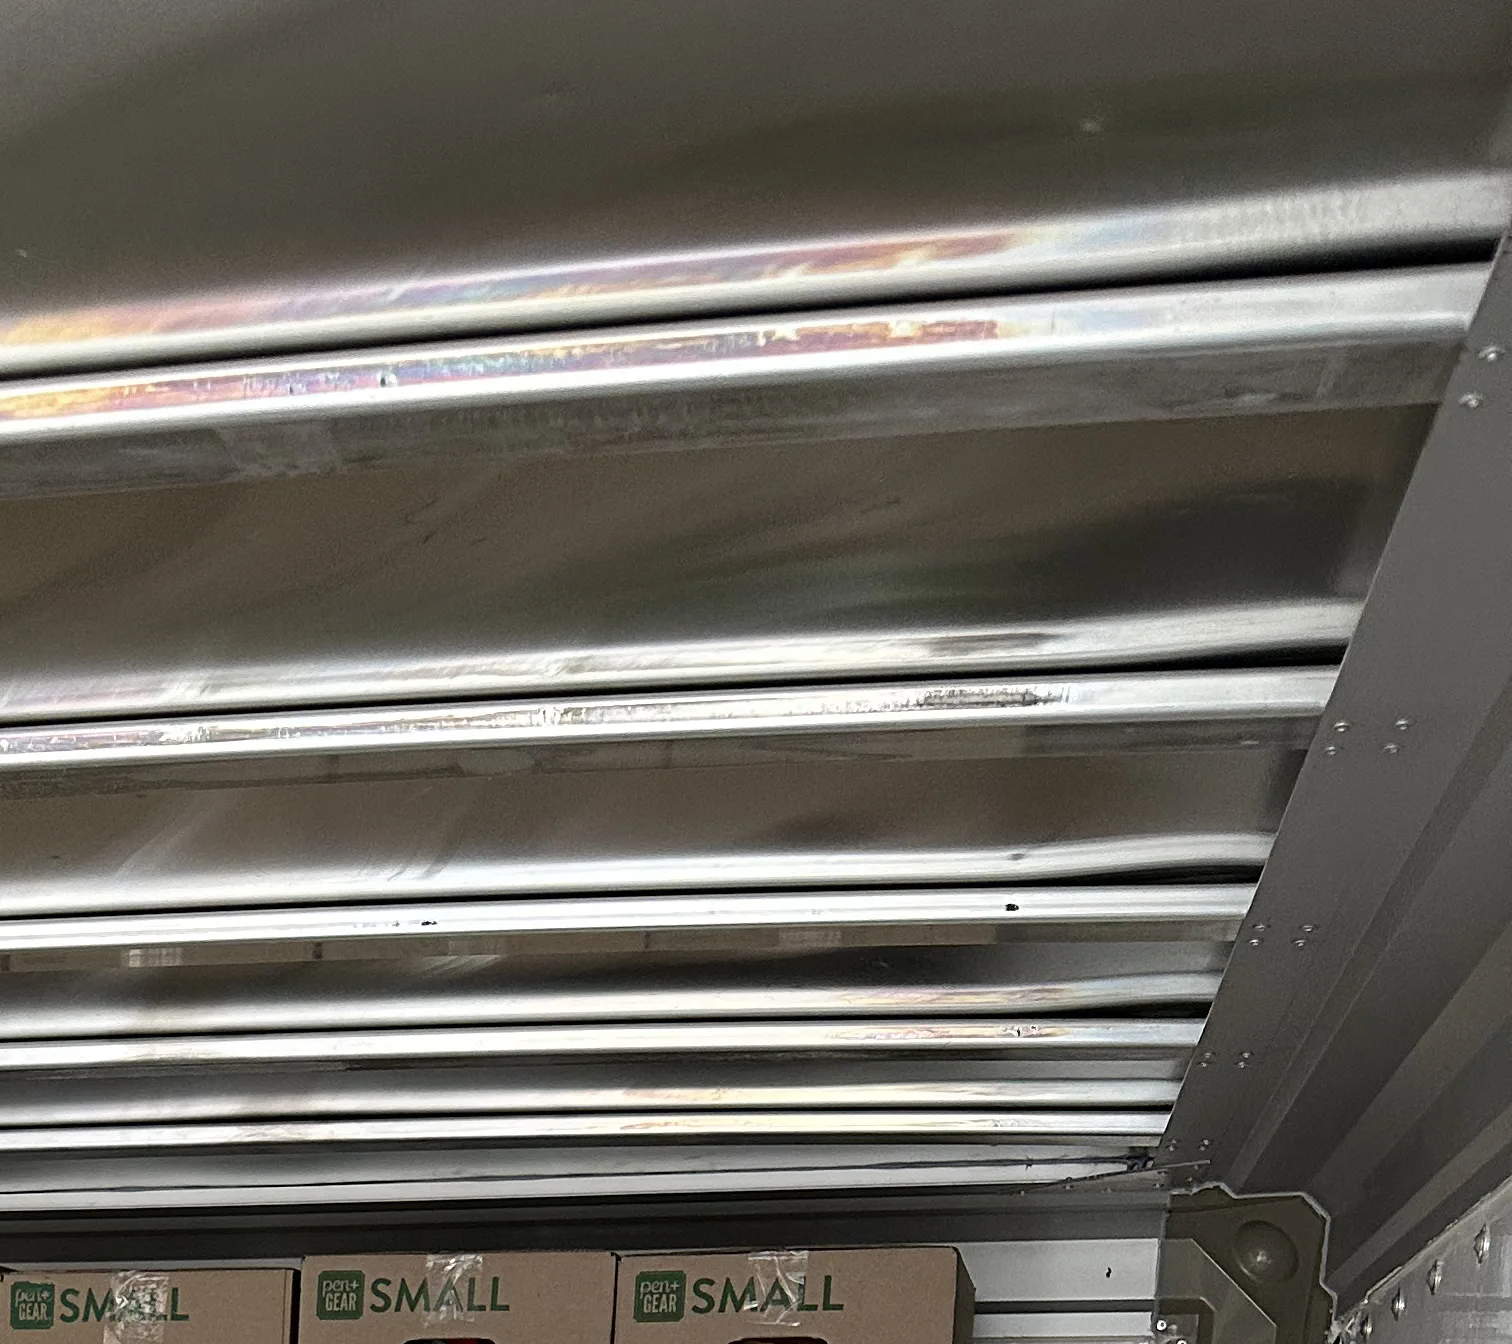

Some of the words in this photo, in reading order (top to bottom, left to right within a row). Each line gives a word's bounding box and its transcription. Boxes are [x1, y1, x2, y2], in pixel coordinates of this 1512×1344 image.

[369, 1276, 510, 1312] SMALL
[643, 1294, 677, 1313] GEAR
[691, 1275, 844, 1313] SMALL
